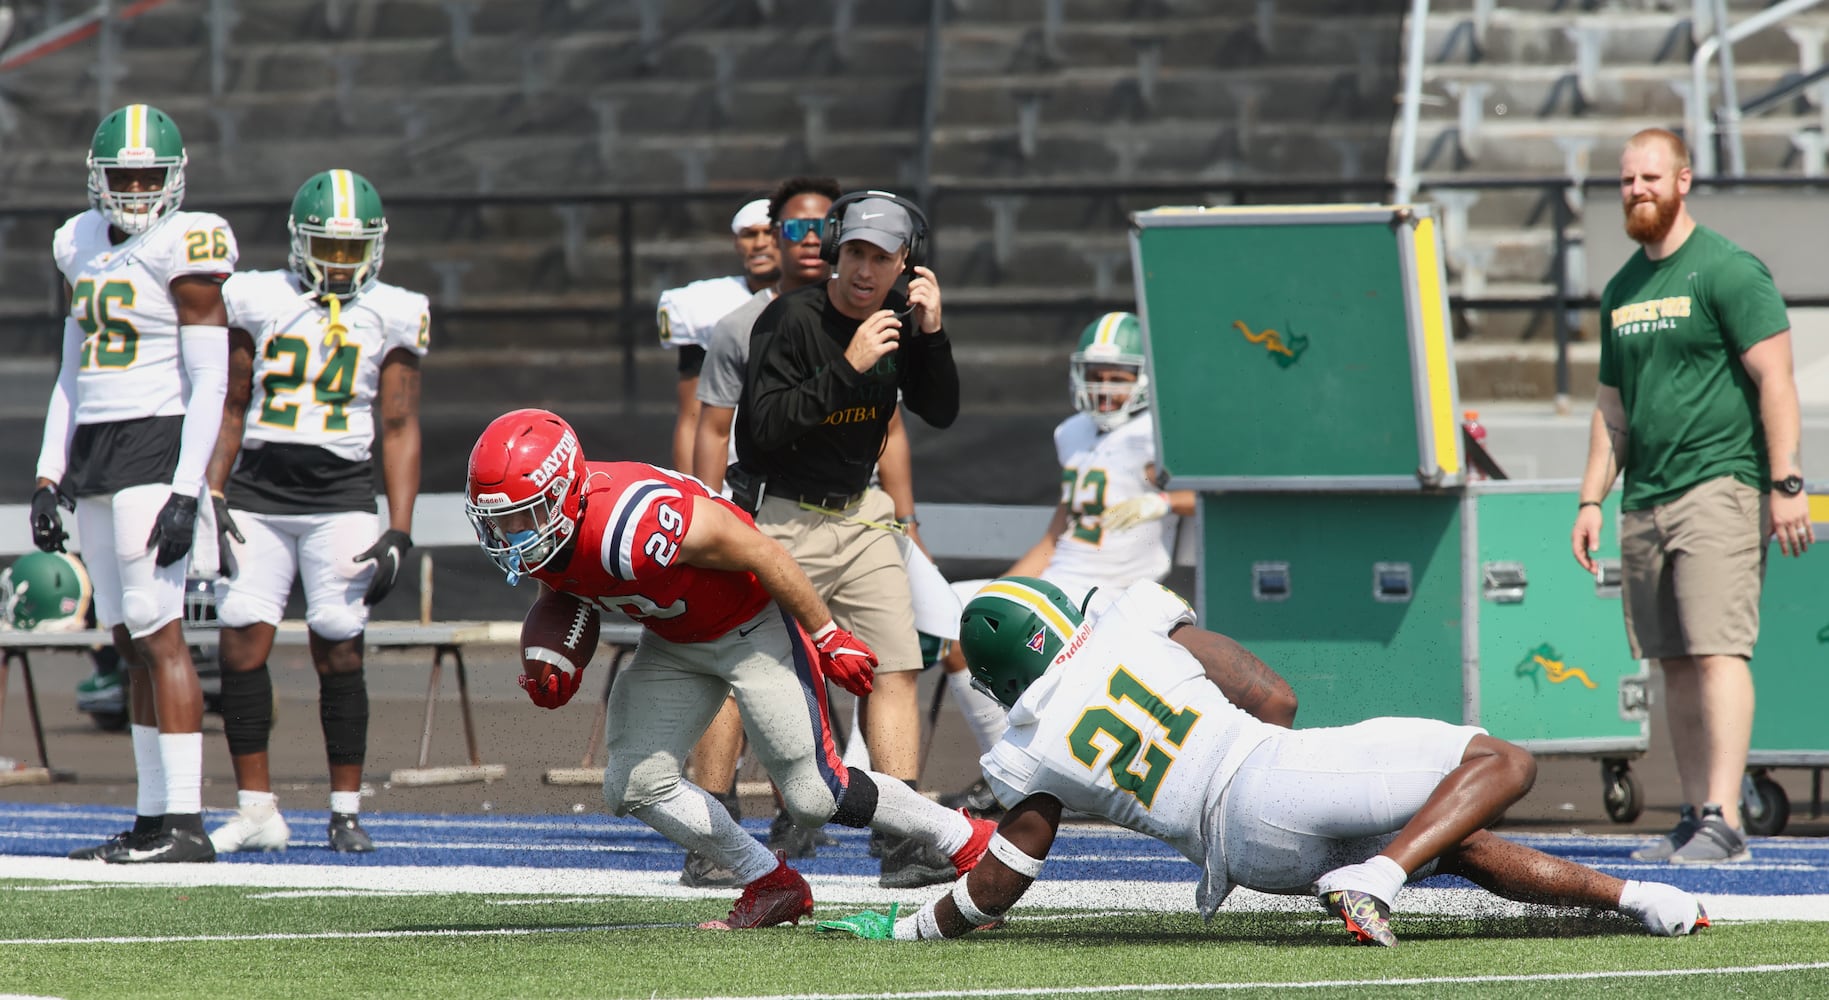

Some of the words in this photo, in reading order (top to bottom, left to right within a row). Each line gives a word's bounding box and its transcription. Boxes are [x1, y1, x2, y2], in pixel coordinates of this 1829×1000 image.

[184, 227, 228, 263] 26
[73, 278, 140, 371] 26
[259, 334, 361, 431] 24
[529, 429, 577, 488] DAYTON
[643, 502, 684, 569] 29
[1055, 624, 1092, 665] Riddell
[1066, 663, 1202, 812] 21
